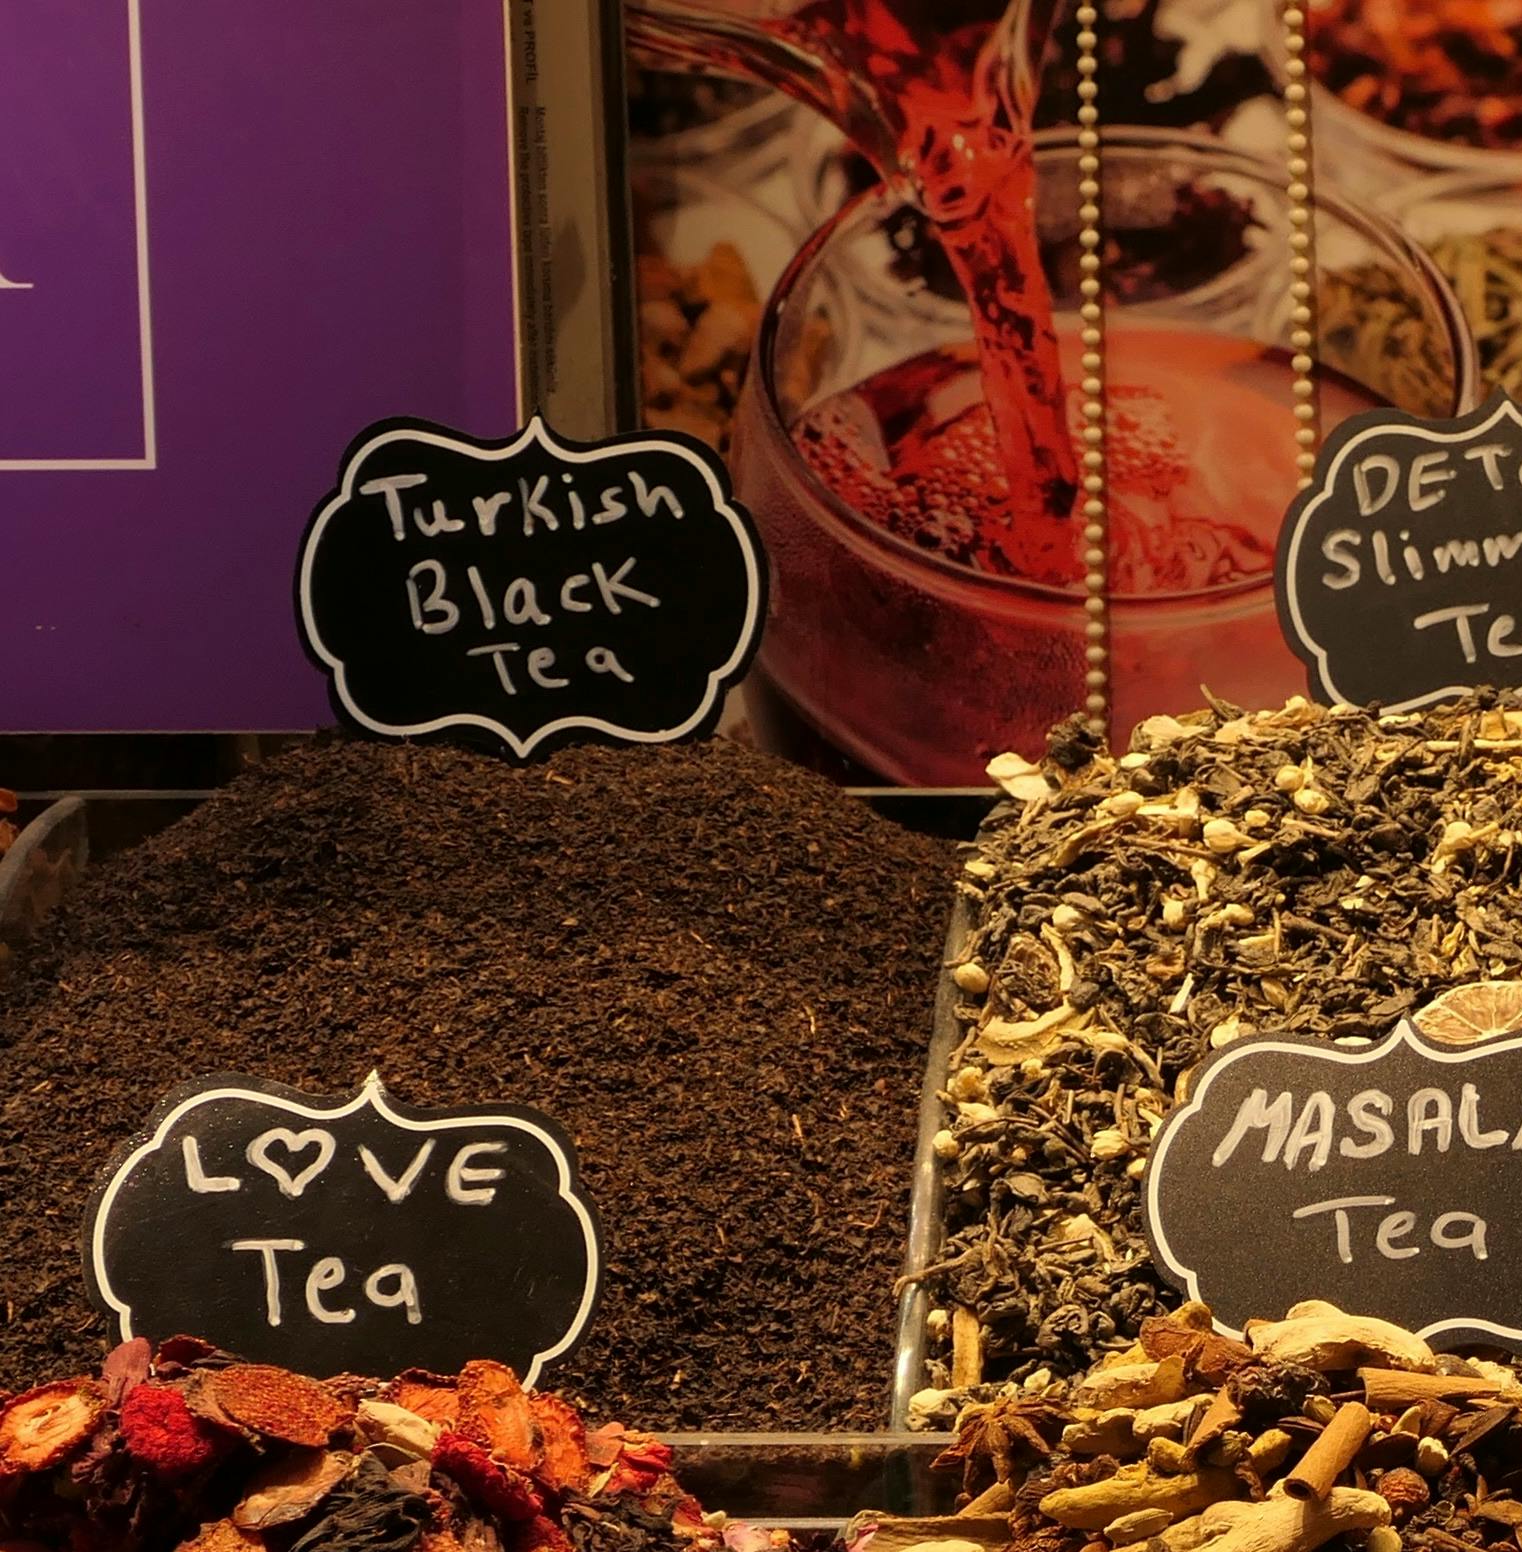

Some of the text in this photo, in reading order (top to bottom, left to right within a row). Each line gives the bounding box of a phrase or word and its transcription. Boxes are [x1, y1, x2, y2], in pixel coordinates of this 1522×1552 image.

[466, 642, 635, 695] Tea
[1291, 1194, 1489, 1264] Tea
[231, 1238, 422, 1327] Tea
